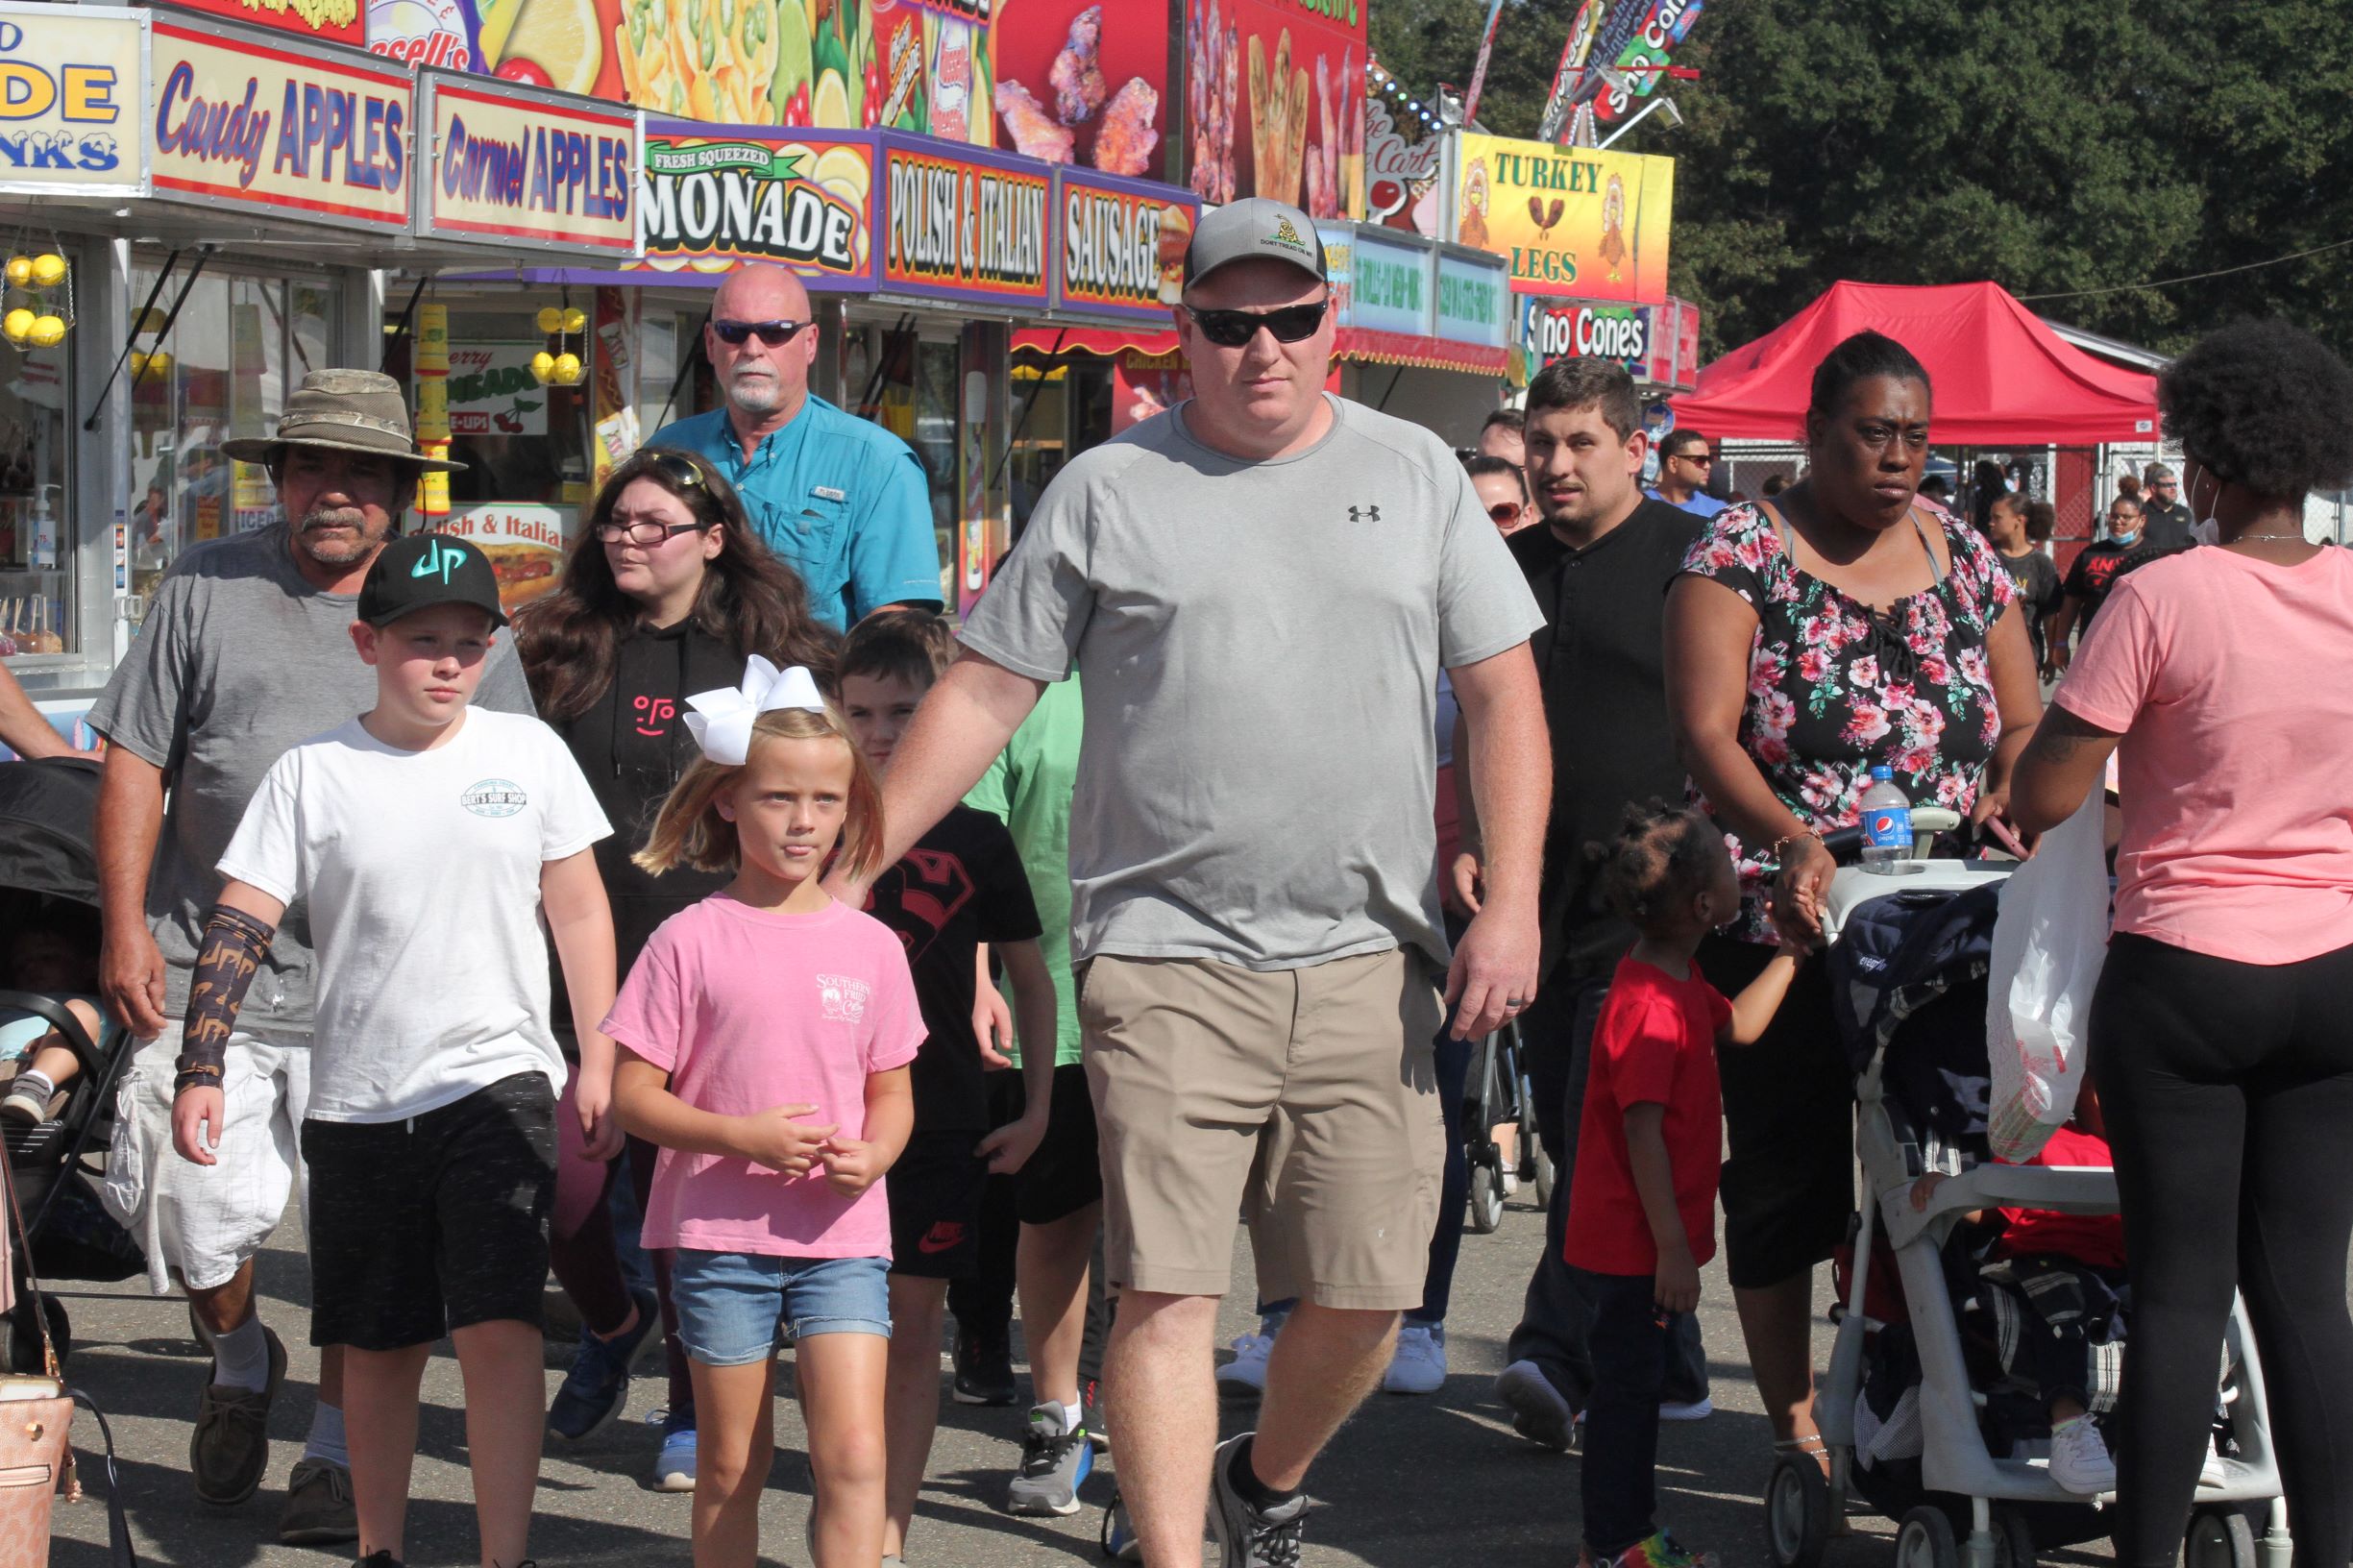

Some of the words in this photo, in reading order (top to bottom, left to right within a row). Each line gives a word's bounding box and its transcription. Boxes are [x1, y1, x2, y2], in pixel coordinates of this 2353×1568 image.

[1608, 55, 1650, 114] Sno
[156, 61, 269, 190] Candy
[273, 79, 404, 194] APPLES
[443, 112, 529, 207] Carmel
[527, 126, 628, 223] APPLES
[653, 153, 697, 170] FRESH
[699, 147, 771, 167] SQUEEZED
[1374, 138, 1439, 174] Cart
[1494, 151, 1605, 195] TURKEY
[645, 171, 853, 269] MONADE
[889, 159, 958, 273] POLISH
[962, 175, 976, 272] &
[978, 175, 1044, 282] ITALIAN
[1066, 192, 1161, 297] SAUSAGE
[1509, 247, 1578, 283] LEGS
[1577, 307, 1644, 358] Cones
[481, 513, 499, 535] &
[488, 793, 506, 804] SURF
[507, 793, 527, 805] SHOP
[816, 973, 870, 995] SOUTHERN
